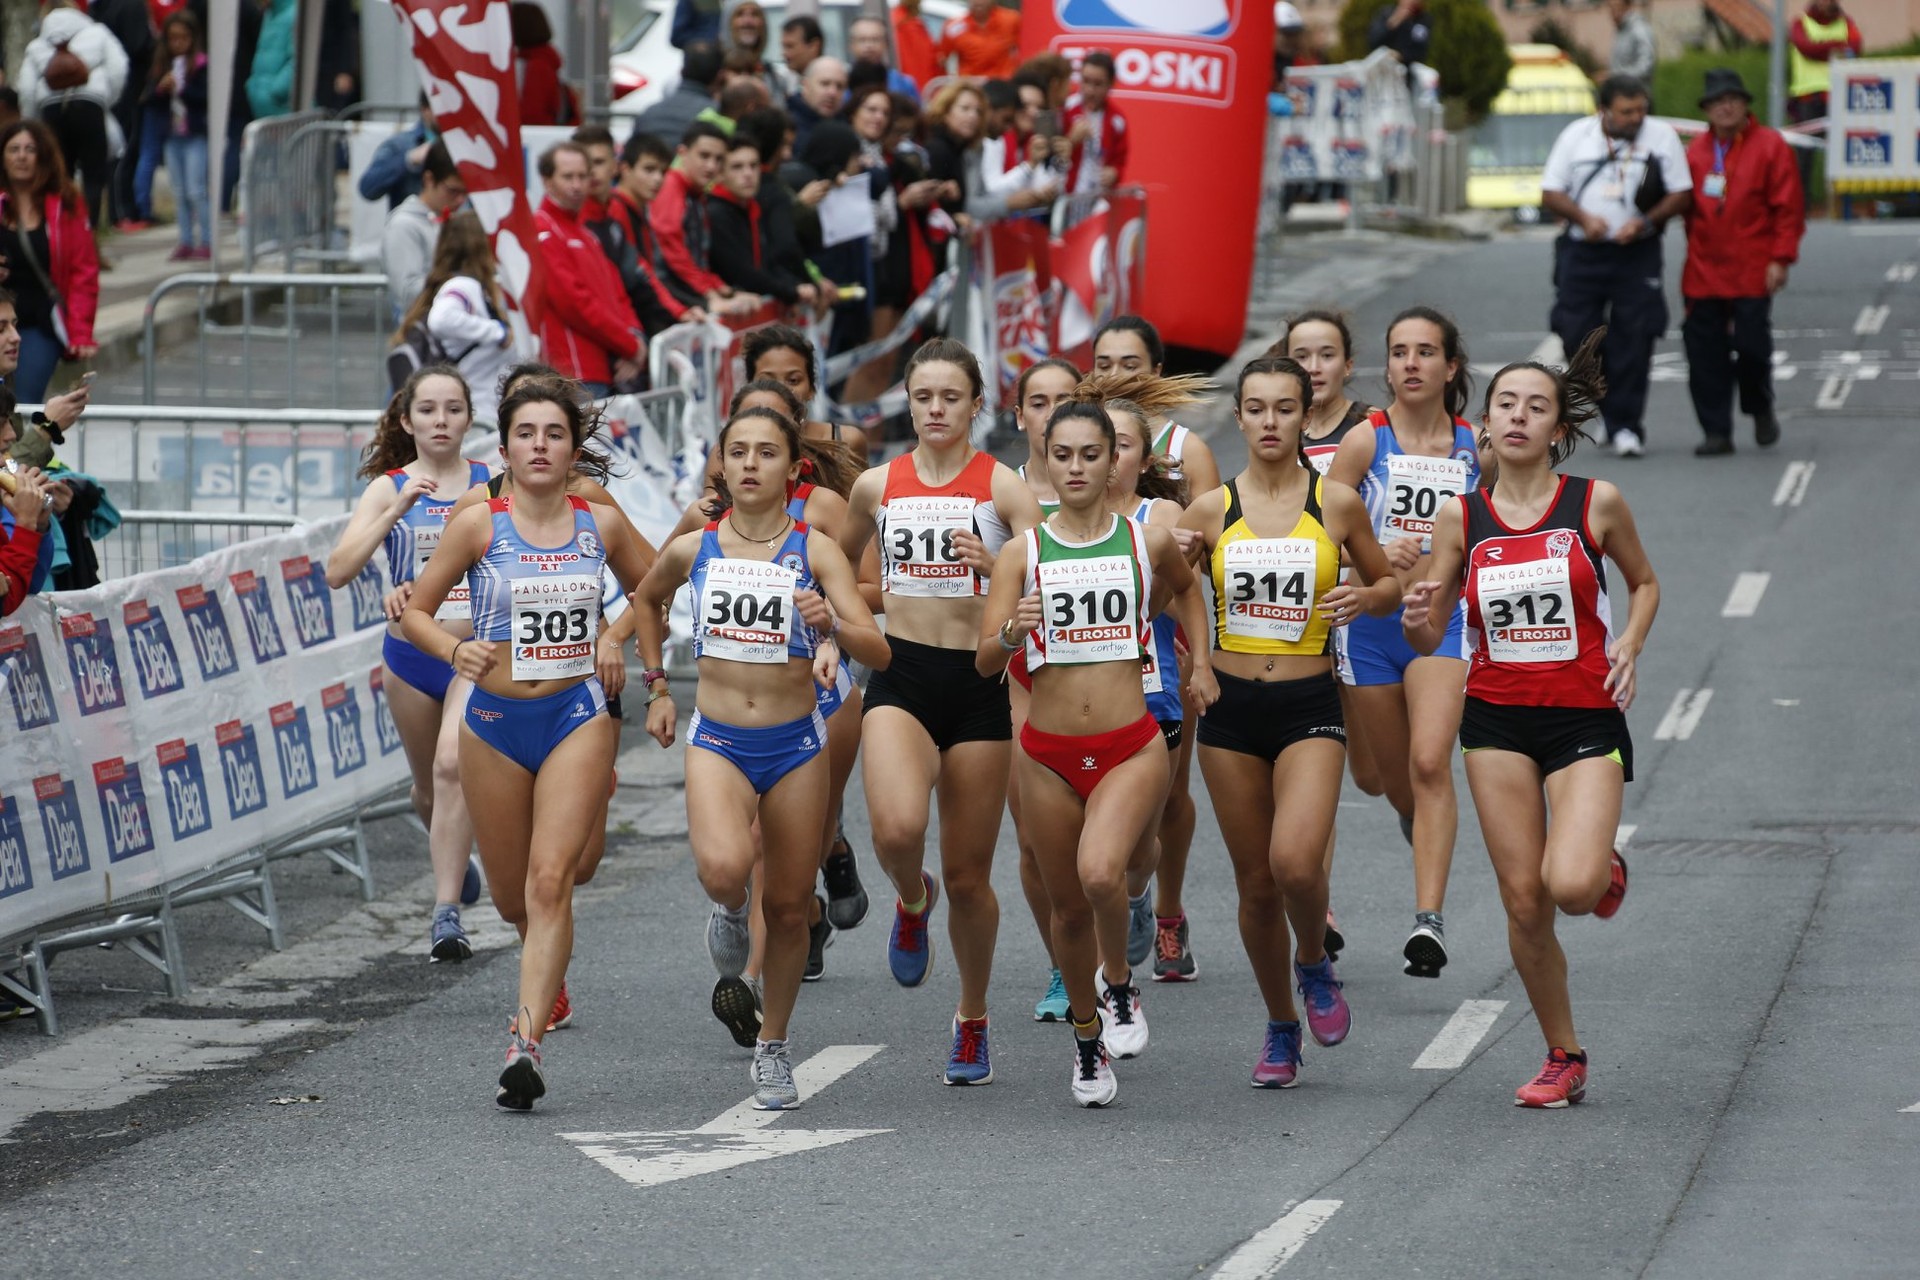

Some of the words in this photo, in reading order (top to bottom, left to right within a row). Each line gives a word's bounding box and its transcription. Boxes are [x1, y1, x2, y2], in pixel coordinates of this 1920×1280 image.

[1061, 47, 1222, 94] EOSKI
[1391, 462, 1462, 474] FANGALOKA
[891, 503, 968, 511] FANGALOKA
[1407, 521, 1433, 532] ERO
[893, 528, 961, 562] 318
[1229, 545, 1311, 554] FANGALOKA
[520, 554, 579, 562] BERANGO
[540, 563, 561, 571] A.T.
[711, 565, 791, 578] FANGALOKA
[913, 566, 964, 576] EROSKI
[1044, 562, 1127, 575] FANGALOKA
[1481, 566, 1563, 583] FANGALOKA
[515, 583, 596, 595] FANGALOKA
[928, 579, 964, 593] contigo
[1233, 572, 1307, 605] 314
[445, 590, 470, 599] ROS
[707, 590, 784, 630] 304
[1052, 589, 1127, 627] 310
[1253, 606, 1304, 620] EROSKI
[1488, 593, 1566, 627] 312
[519, 608, 588, 644] 303
[1269, 622, 1303, 637] contigo
[134, 624, 177, 691] Deia
[190, 609, 232, 674] Deia
[290, 580, 329, 642] Deia
[726, 631, 780, 643] EROSKI
[1073, 628, 1127, 640] EROSKI
[1514, 630, 1567, 640] EROSKI
[540, 644, 587, 657] EROSKI
[742, 644, 779, 659] contigo
[1091, 641, 1127, 656] contigo
[1531, 643, 1567, 657] contigo
[557, 659, 586, 672] contigo
[0, 818, 25, 891] eia
[45, 801, 83, 871] Deia
[105, 784, 146, 854] Deia
[167, 765, 205, 833] Deia
[225, 745, 260, 812] Deia
[279, 725, 312, 792] Deia
[330, 706, 361, 771] Deia
